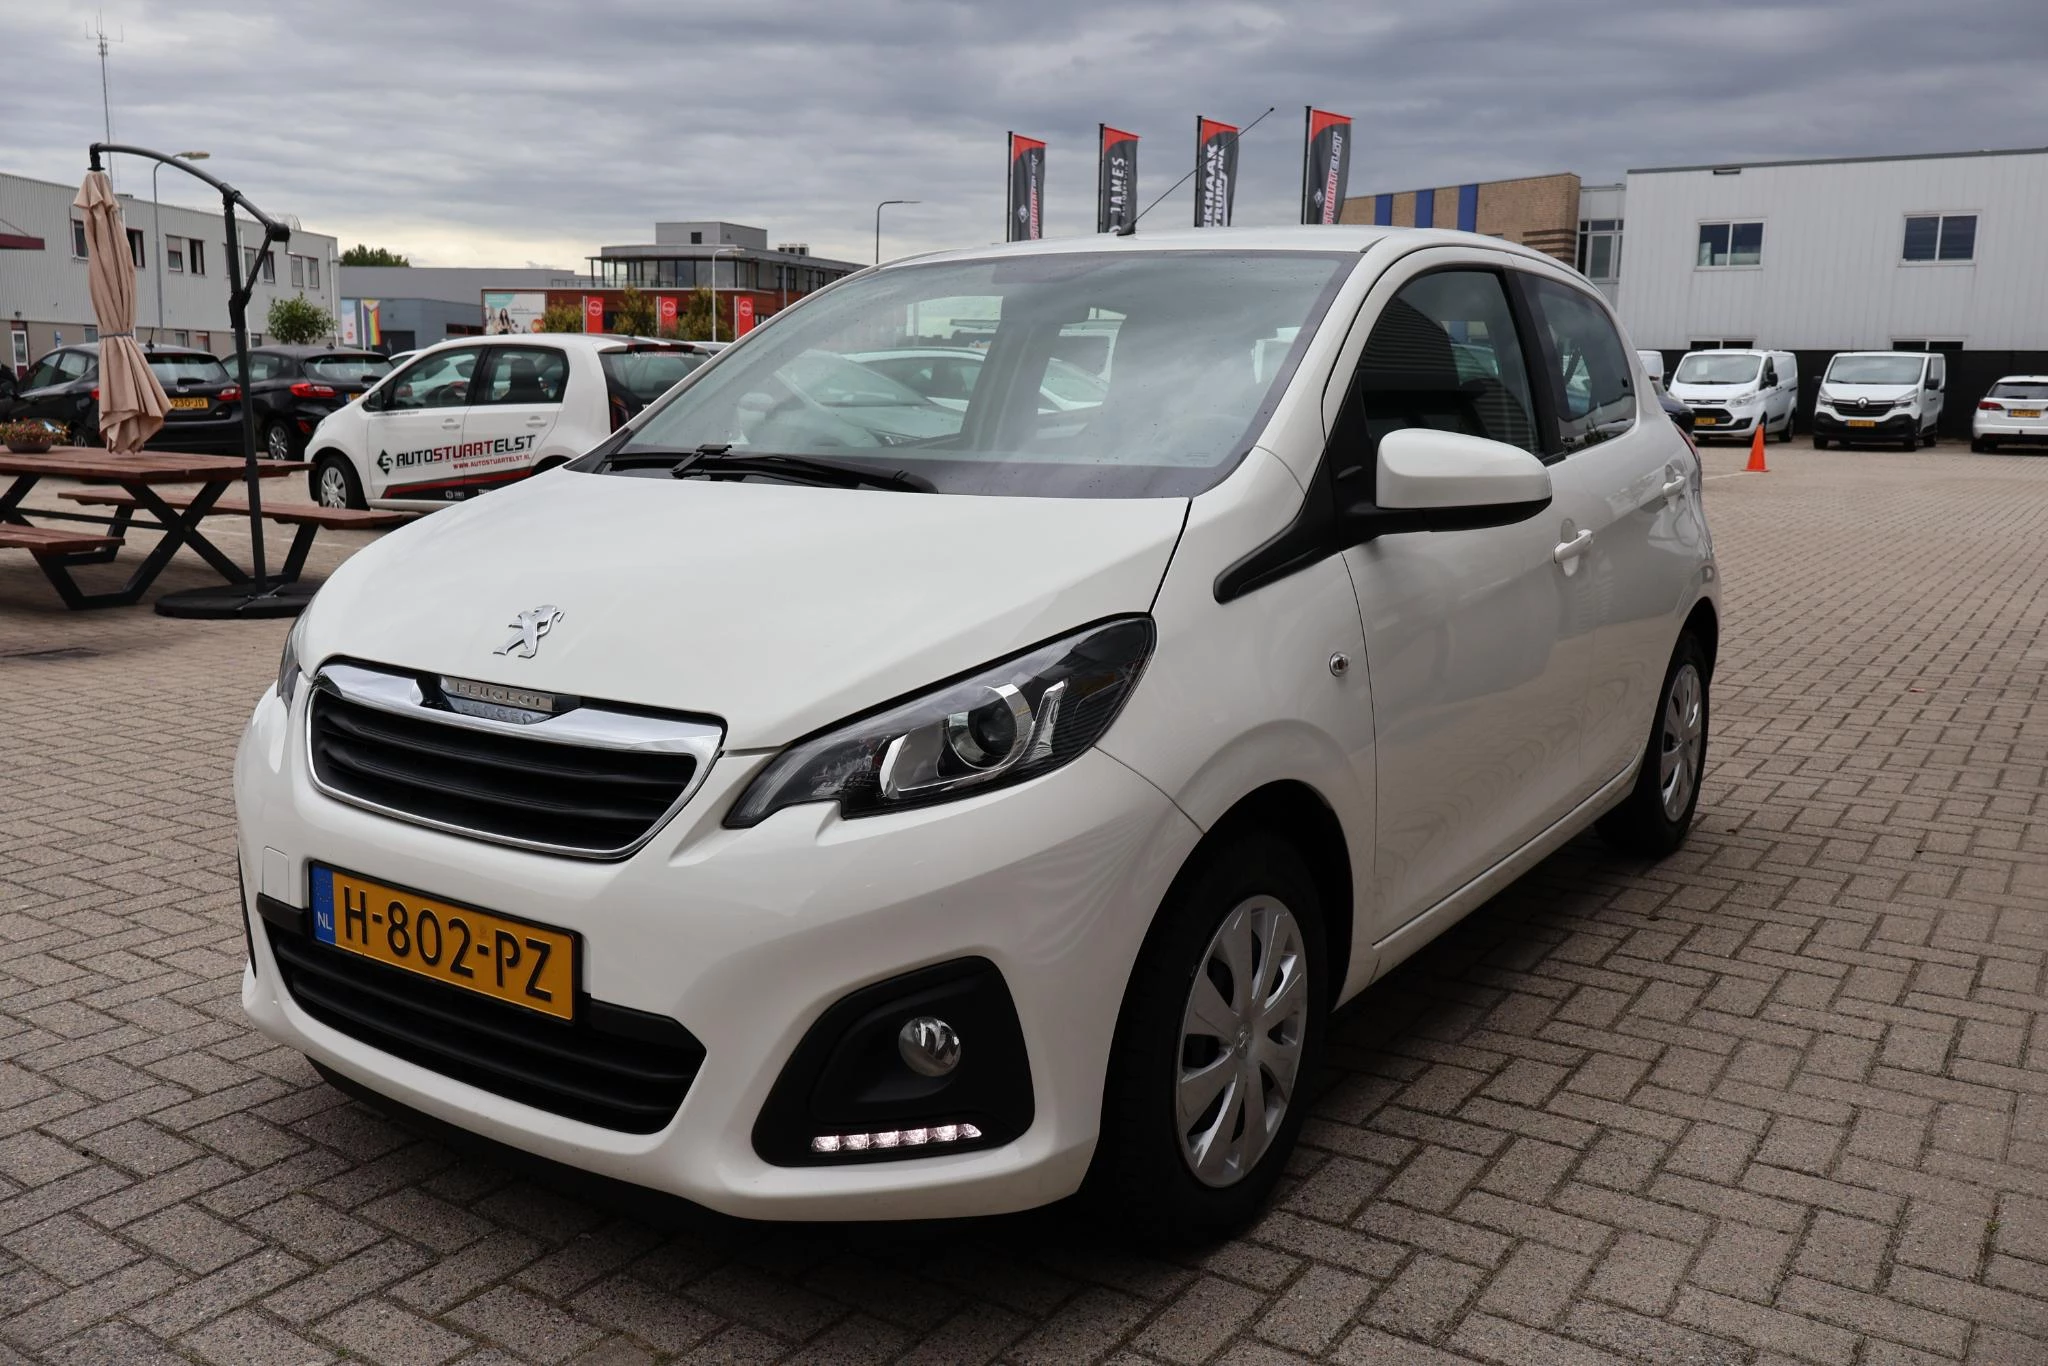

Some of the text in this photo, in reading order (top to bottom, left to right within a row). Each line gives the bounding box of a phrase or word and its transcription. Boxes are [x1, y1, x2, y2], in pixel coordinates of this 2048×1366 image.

[1110, 157, 1125, 214] JAMES
[396, 434, 536, 467] AUTOSTUARTELST
[456, 682, 542, 708] PEUGEOT
[317, 911, 333, 931] NL
[343, 884, 553, 1003] H-802-PZ
